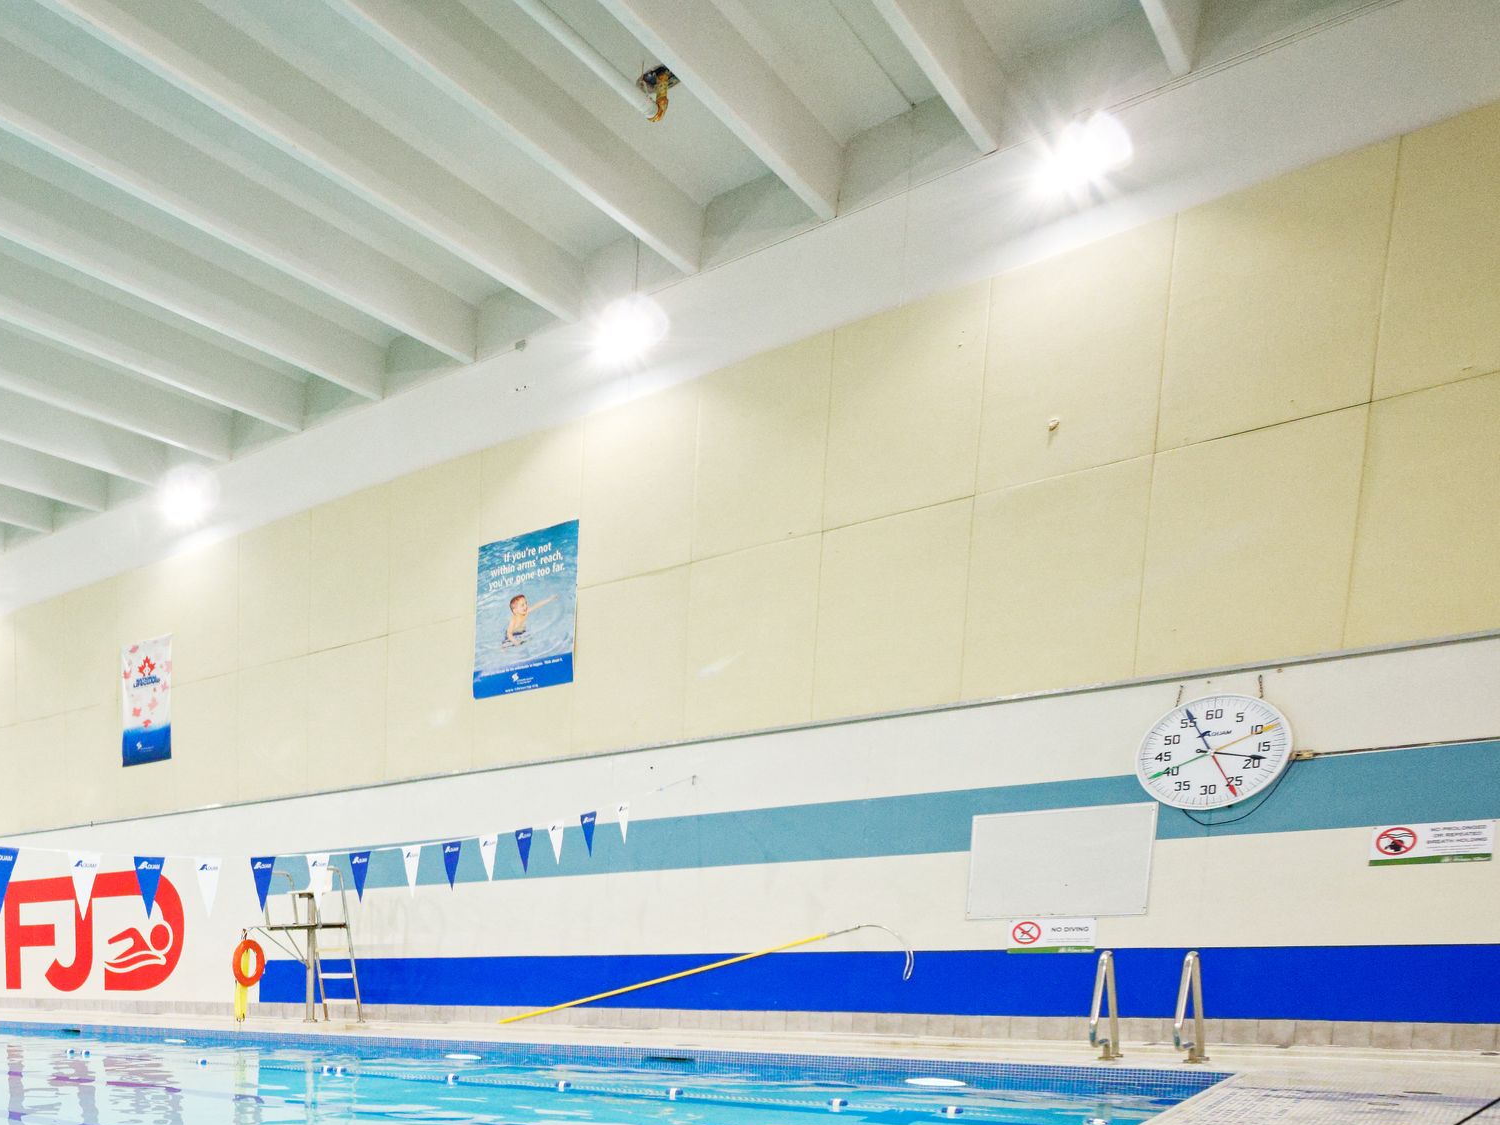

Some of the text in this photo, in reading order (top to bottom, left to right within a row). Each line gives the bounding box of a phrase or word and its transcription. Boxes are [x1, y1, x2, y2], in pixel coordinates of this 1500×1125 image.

[503, 542, 552, 564] If you're not
[488, 562, 566, 592] you've gone too far.
[490, 564, 516, 578] within
[1205, 709, 1223, 720] 60
[1235, 712, 1245, 723] 5
[1180, 718, 1197, 729] 55
[1250, 724, 1264, 735] 10
[1163, 734, 1181, 746] 50
[1257, 741, 1271, 752] 15
[1154, 751, 1172, 763] 45
[1242, 758, 1261, 770] 20
[1162, 766, 1180, 777] 40
[1173, 780, 1191, 792] 35
[1225, 776, 1244, 788] 25
[1199, 784, 1217, 796] 30
